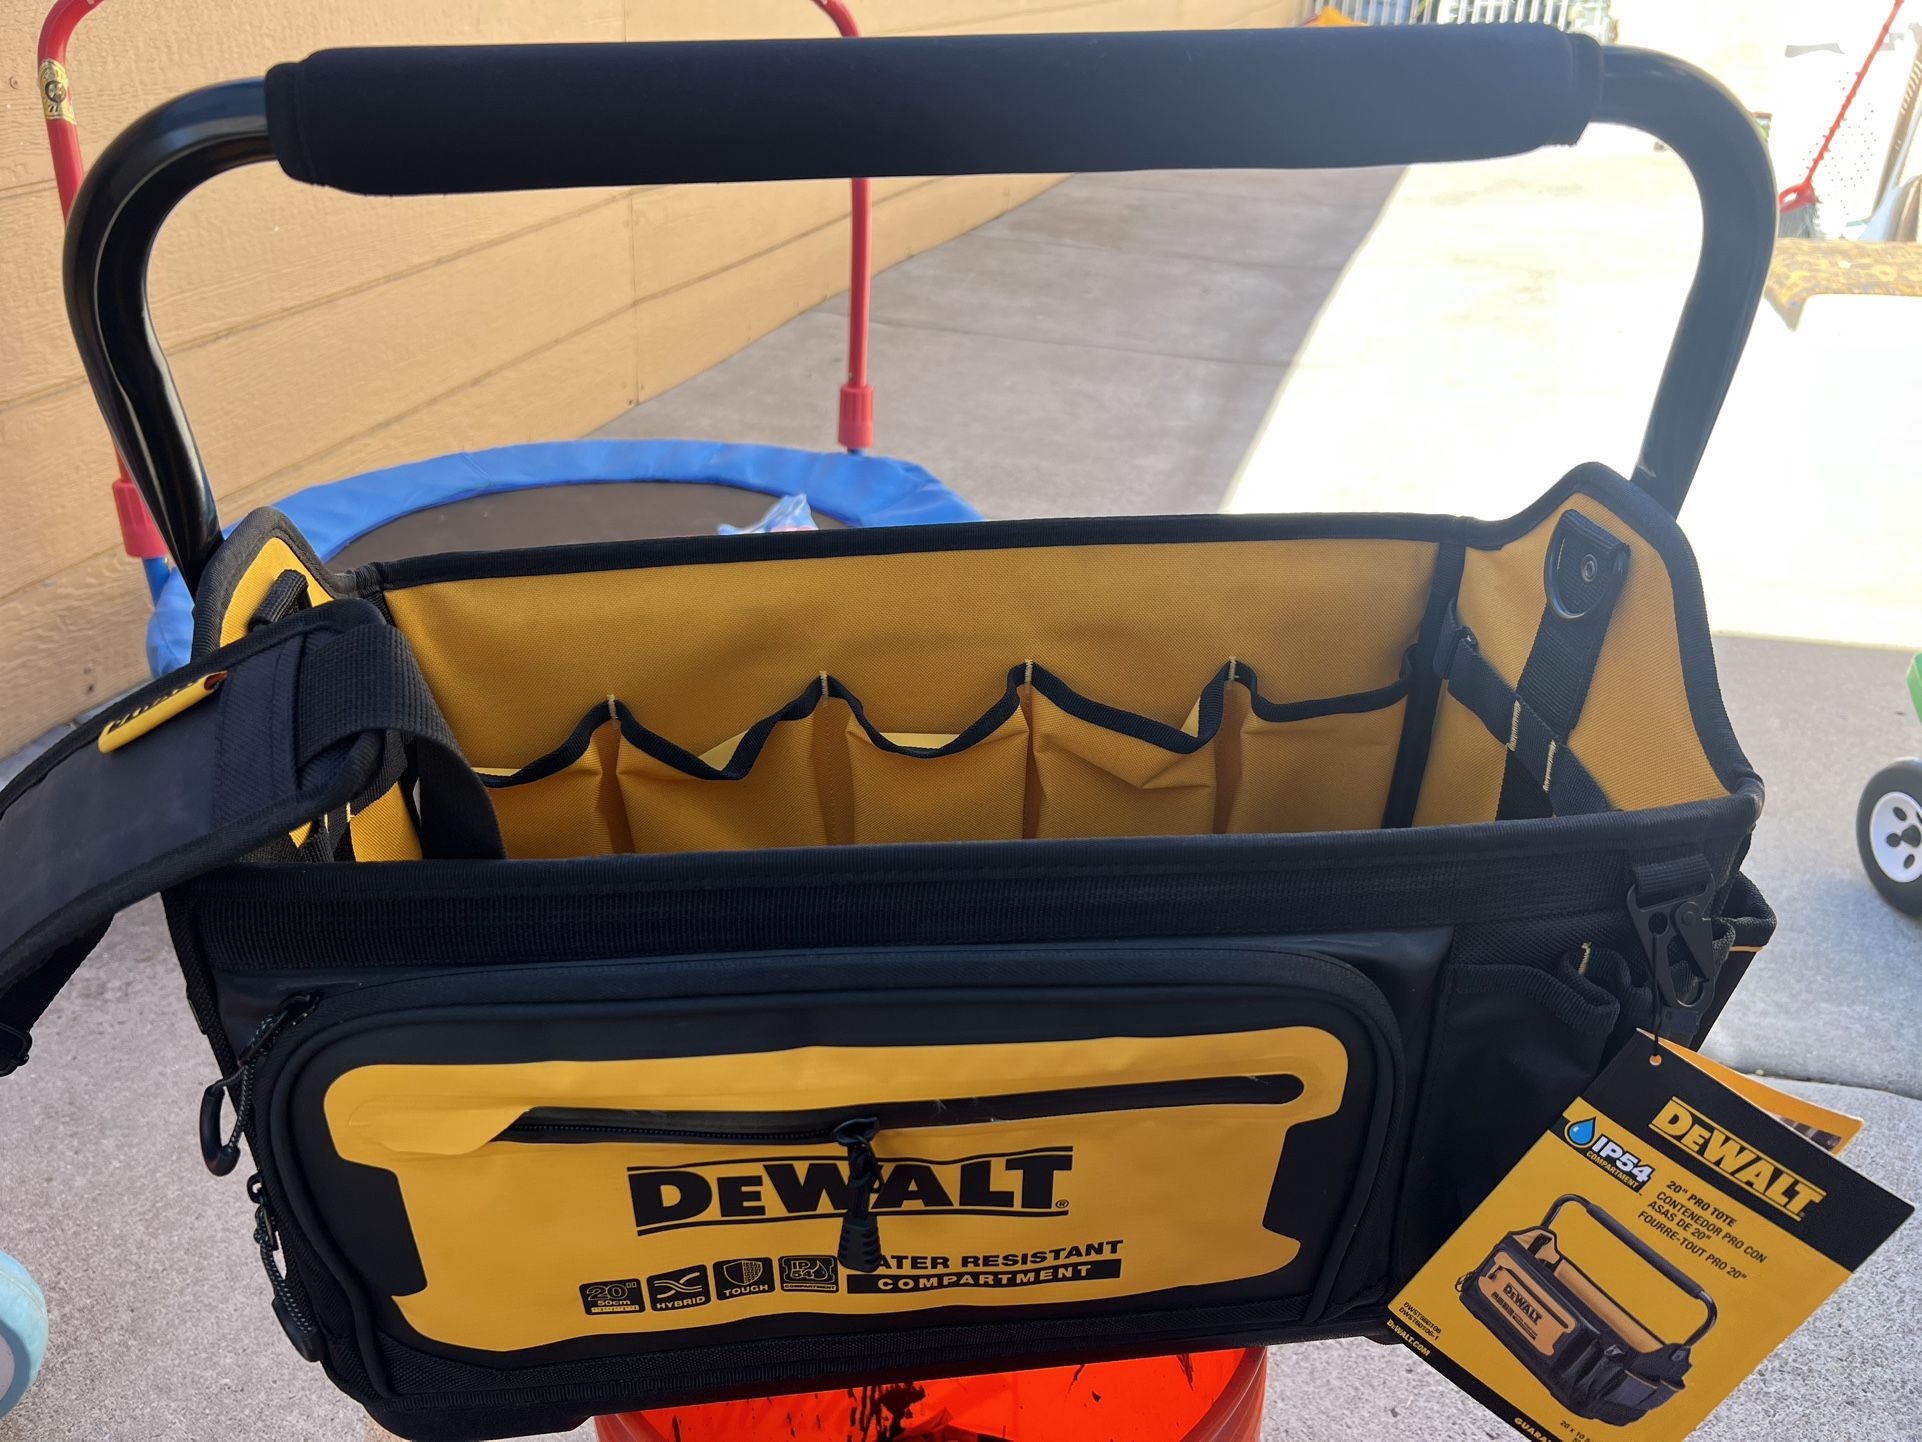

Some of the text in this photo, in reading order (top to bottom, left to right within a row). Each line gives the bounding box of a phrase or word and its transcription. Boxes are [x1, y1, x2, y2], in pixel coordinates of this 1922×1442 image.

[1586, 1151, 1640, 1189] COMPARTMENT
[1591, 1135, 1653, 1182] IP54
[1649, 1097, 1826, 1219] DEWALT
[628, 1155, 1073, 1228] DEWALT
[1648, 1201, 1677, 1222] ASAS
[1676, 1218, 1693, 1232] DE
[1687, 1194, 1711, 1211] PRO
[1711, 1207, 1737, 1227] TOTE
[1638, 1211, 1708, 1257] FOURRE-TOUT
[1705, 1253, 1728, 1270] PRO
[1657, 1192, 1768, 1263] CONTENEDOR PRO CON
[791, 1260, 811, 1271] IP
[878, 1240, 1124, 1270] ATER RESISTANT
[723, 1284, 769, 1296] TOUGH
[877, 1265, 1092, 1290] COMPARTMENT
[656, 1295, 705, 1310] HYBRID
[1386, 1319, 1431, 1357] DEWALT.COM
[1514, 1417, 1552, 1442] GUARA
